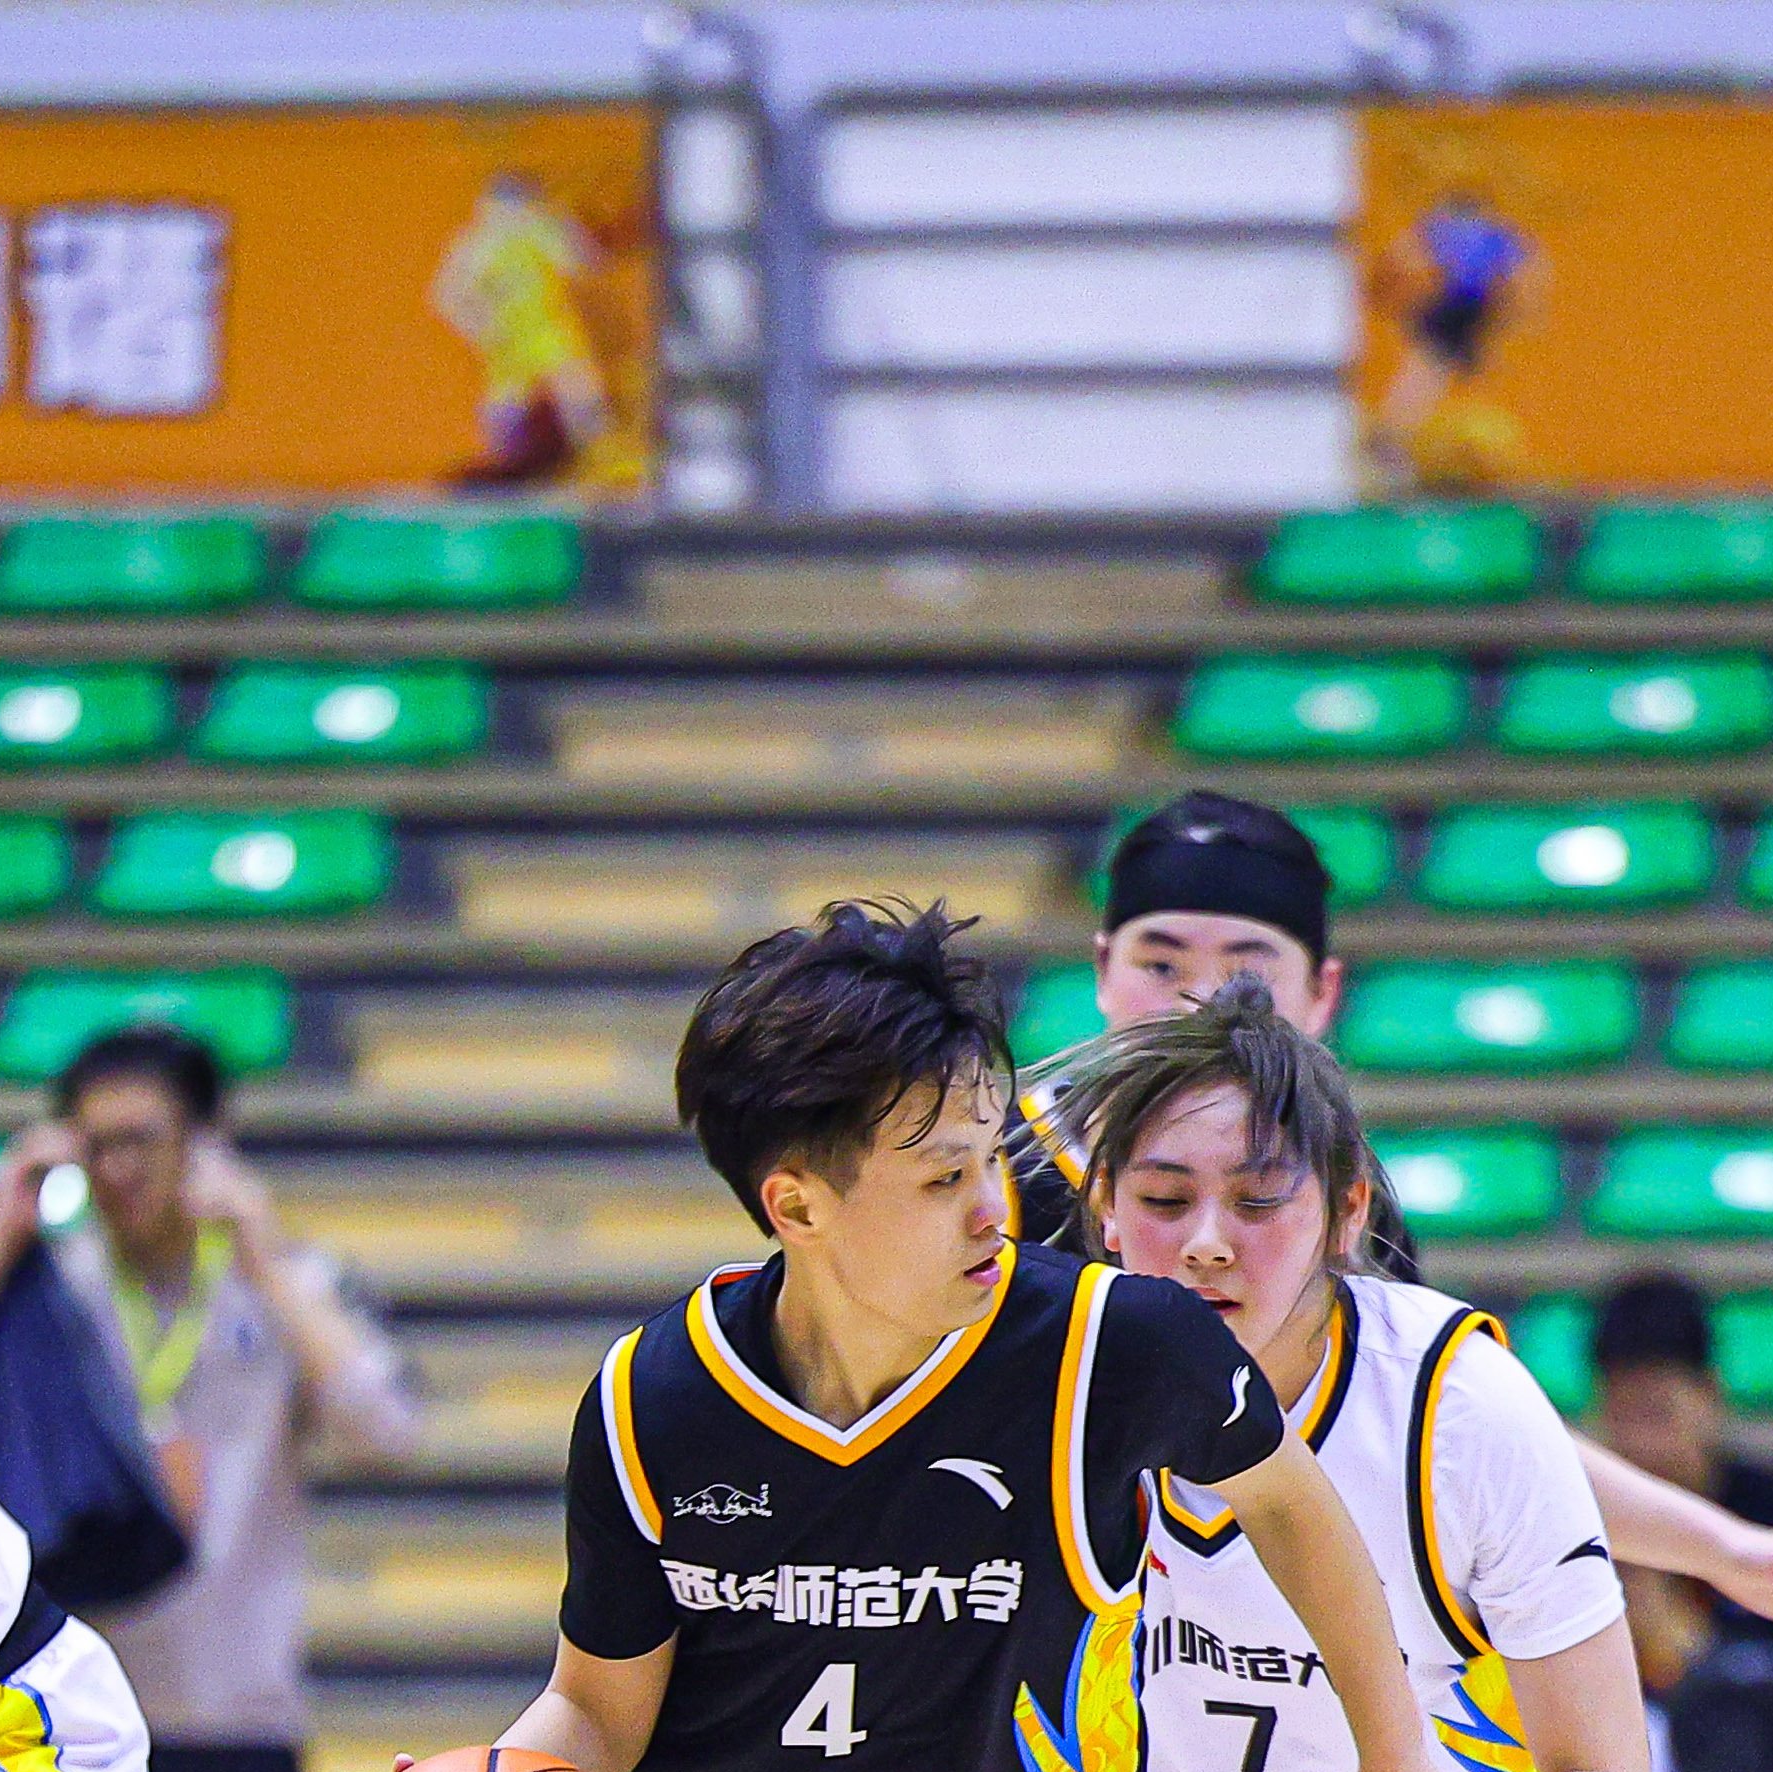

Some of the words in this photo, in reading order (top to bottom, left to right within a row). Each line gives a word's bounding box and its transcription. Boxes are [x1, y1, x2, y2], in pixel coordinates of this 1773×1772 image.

[659, 1558, 1026, 1629] 西华师范大学
[780, 1663, 868, 1757] 4
